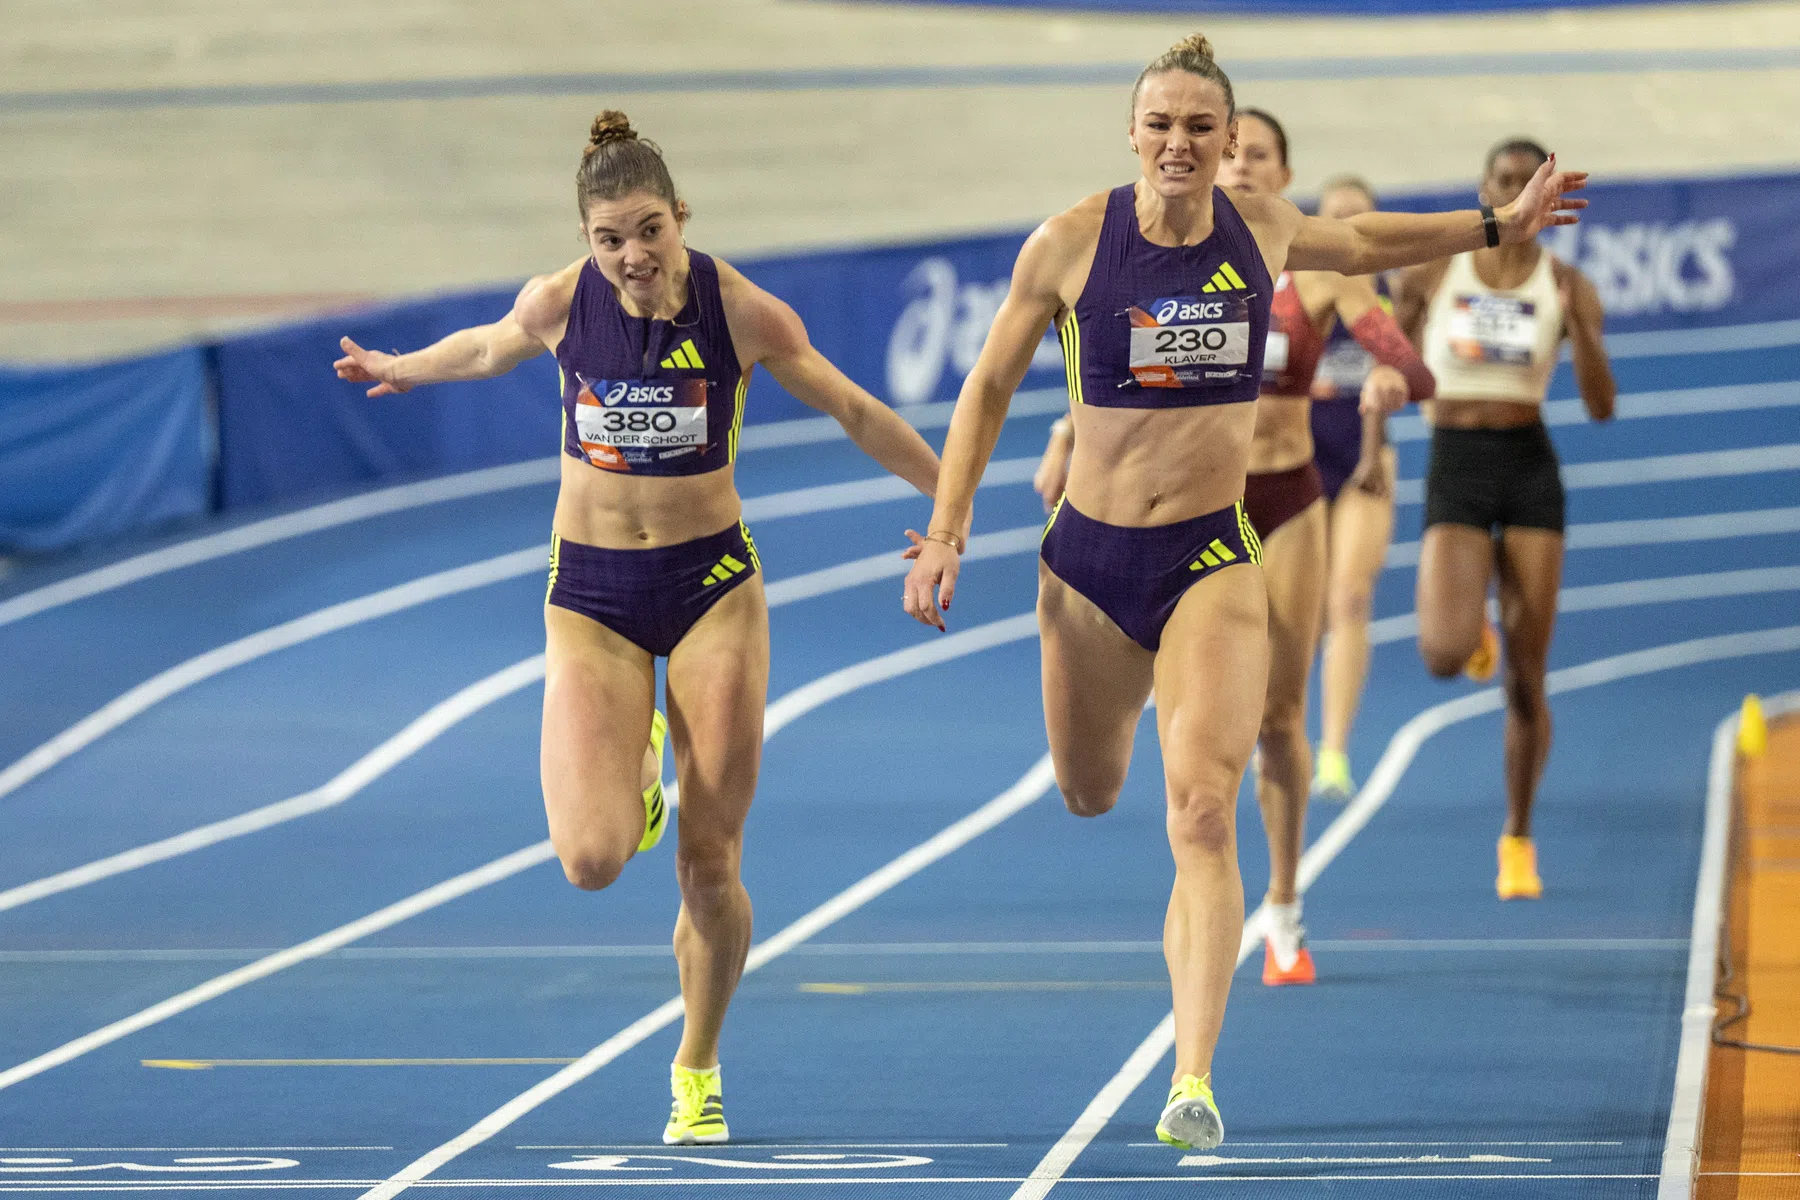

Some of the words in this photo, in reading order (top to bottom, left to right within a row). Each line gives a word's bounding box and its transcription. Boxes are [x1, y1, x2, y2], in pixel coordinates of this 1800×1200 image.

[1155, 327, 1227, 353] 230
[1165, 354, 1217, 364] KLAVER
[603, 411, 677, 432] 380
[585, 432, 611, 443] VAN
[614, 434, 640, 443] DER
[643, 434, 697, 444] SCHOOT
